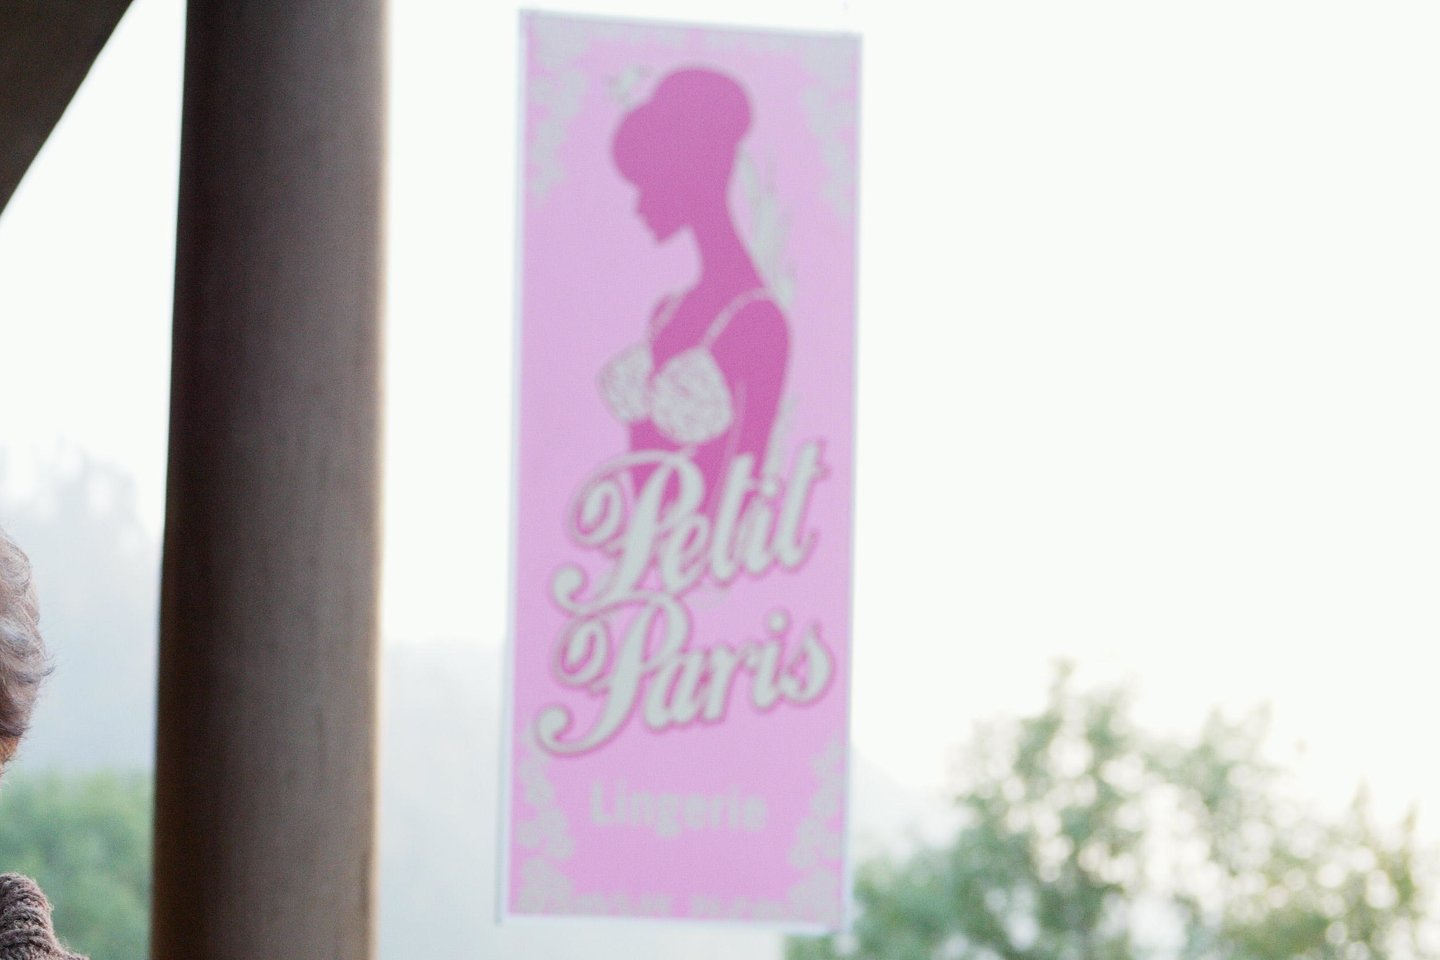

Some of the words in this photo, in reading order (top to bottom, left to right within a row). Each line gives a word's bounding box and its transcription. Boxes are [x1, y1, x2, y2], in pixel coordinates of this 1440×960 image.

[549, 438, 830, 618] Petit
[536, 590, 836, 758] Paris
[591, 779, 767, 839] Lingerie
